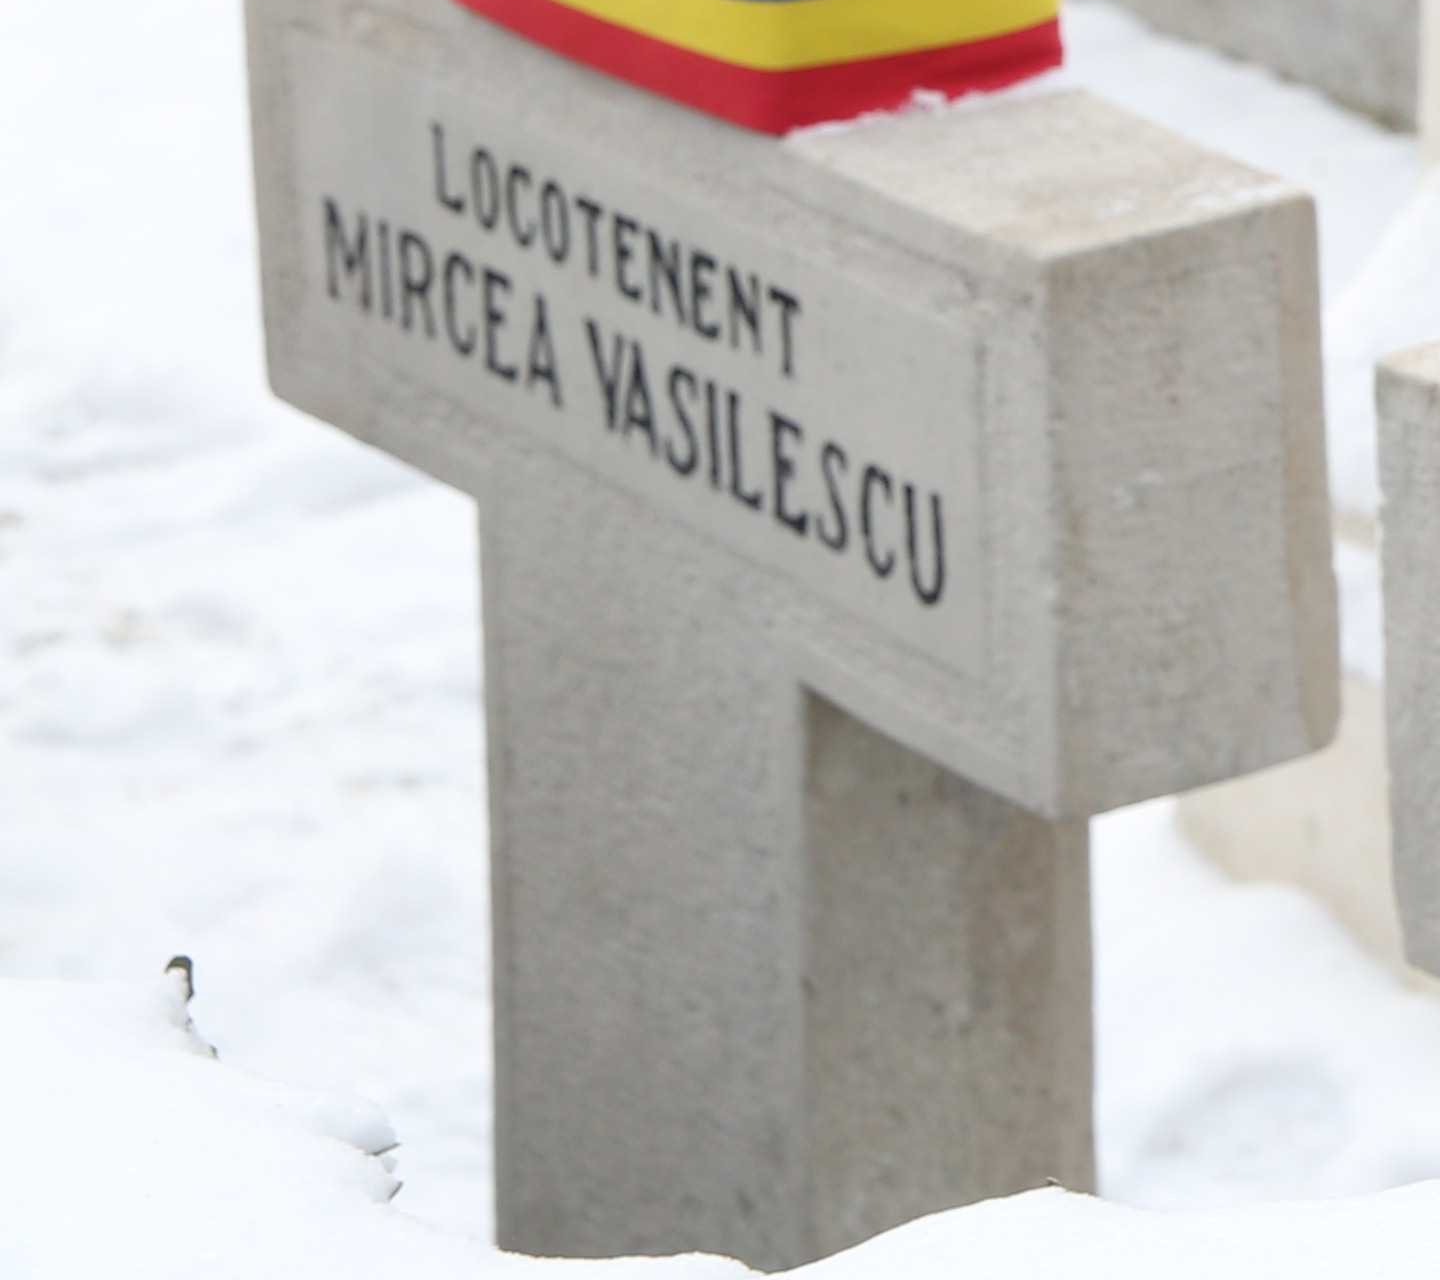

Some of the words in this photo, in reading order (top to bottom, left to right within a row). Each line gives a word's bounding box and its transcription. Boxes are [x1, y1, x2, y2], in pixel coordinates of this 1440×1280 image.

[321, 197, 564, 409] MIRCEA
[584, 319, 946, 605] VASILESCU
[431, 123, 803, 378] LOCOTENENT
